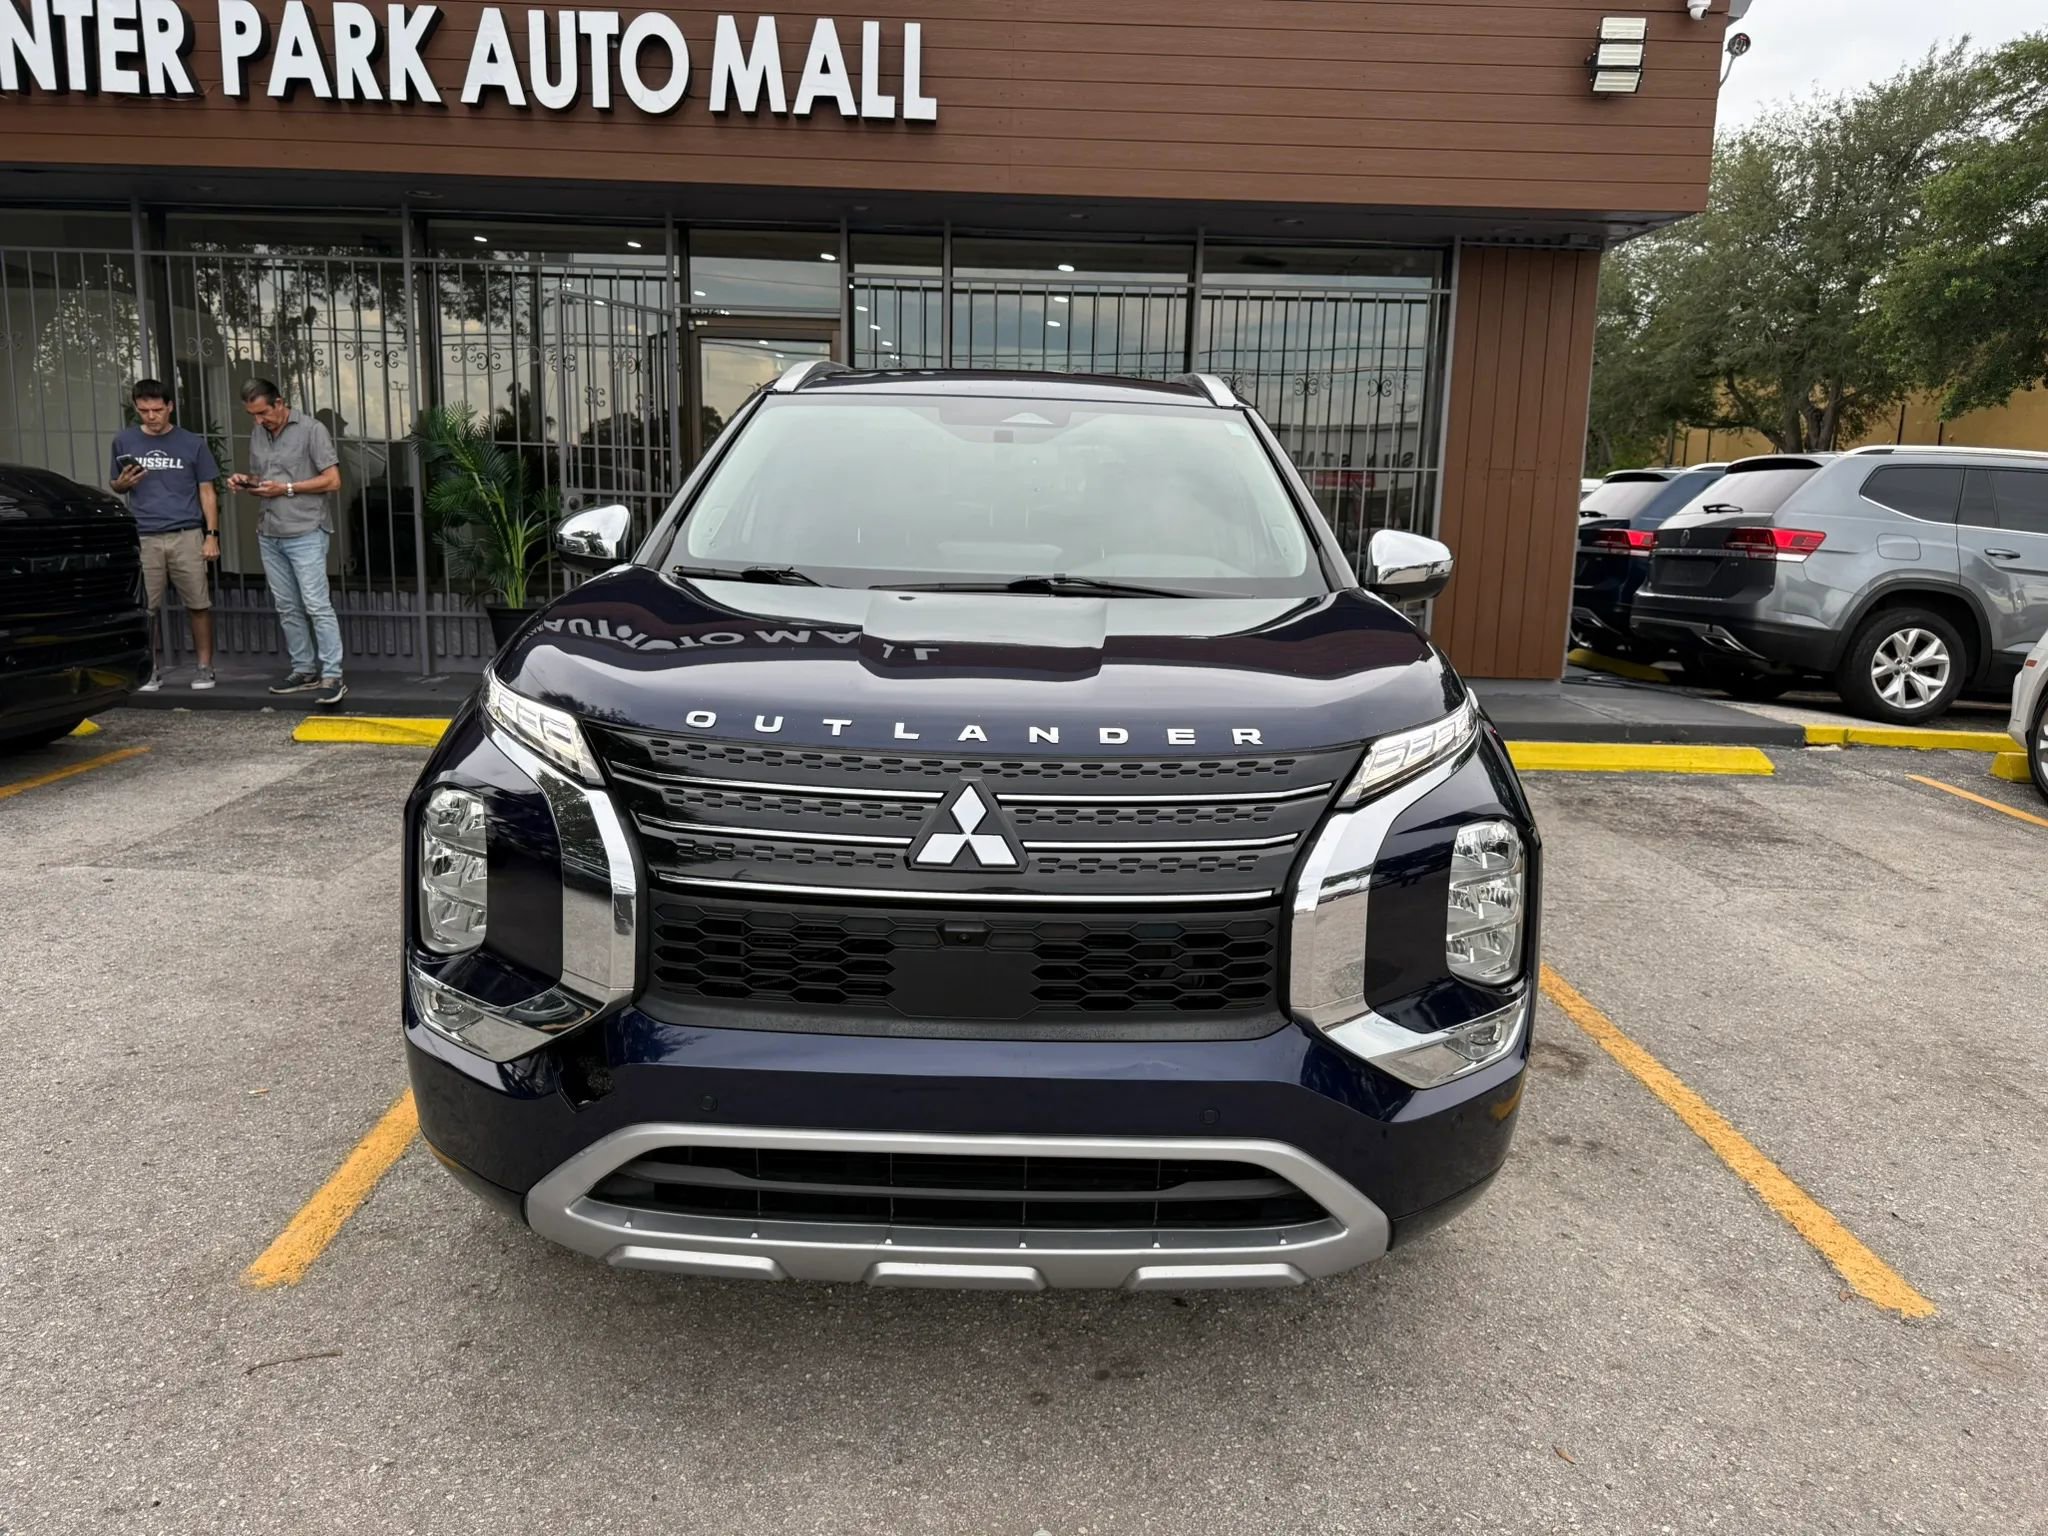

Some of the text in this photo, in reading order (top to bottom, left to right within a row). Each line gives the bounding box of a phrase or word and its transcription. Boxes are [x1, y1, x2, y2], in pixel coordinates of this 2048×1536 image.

[0, 0, 937, 120] NTER PARK AUTO MALL
[134, 456, 184, 470] USSELL
[686, 711, 1262, 745] OUTLANDER
